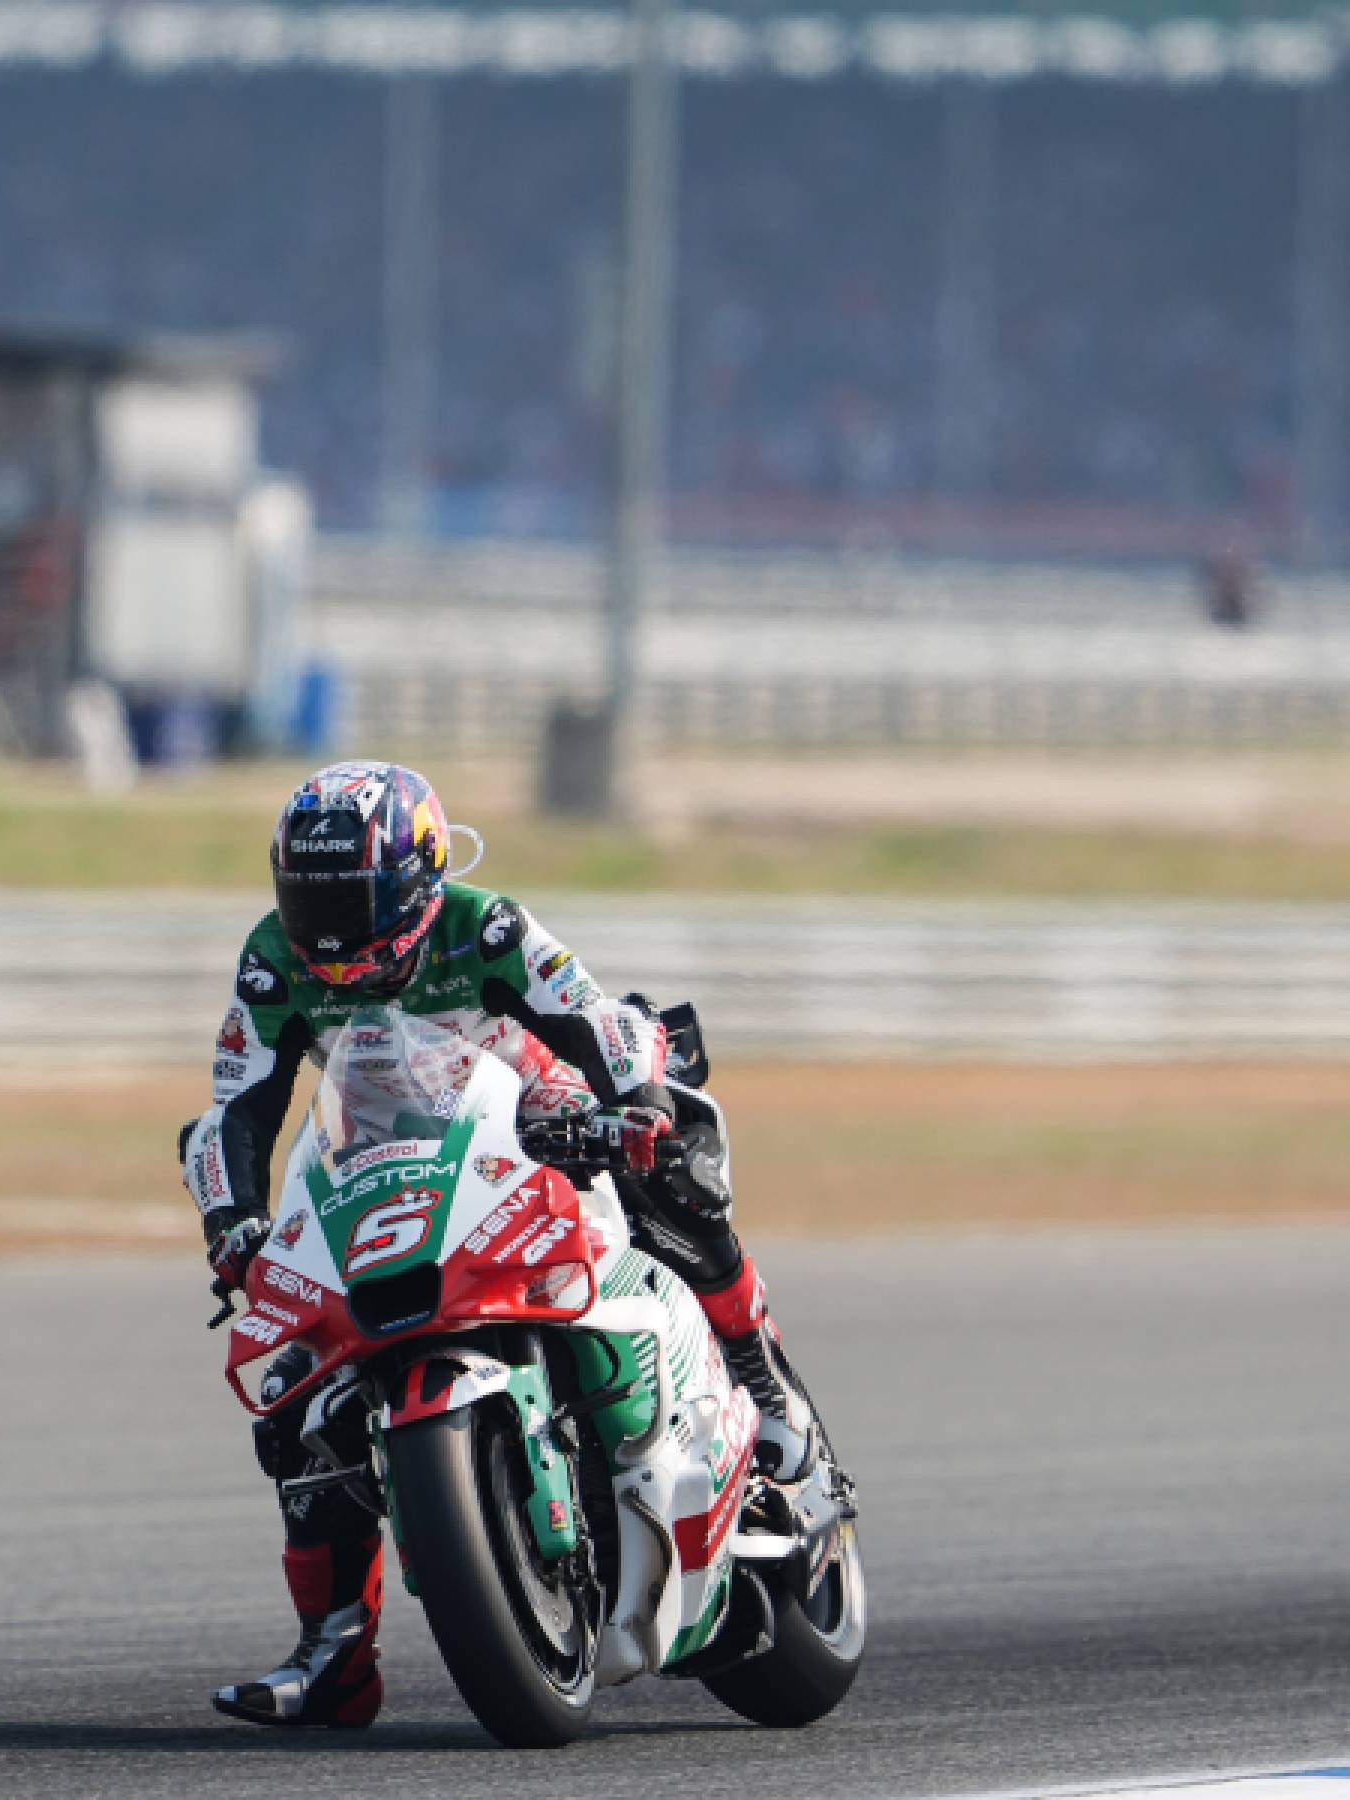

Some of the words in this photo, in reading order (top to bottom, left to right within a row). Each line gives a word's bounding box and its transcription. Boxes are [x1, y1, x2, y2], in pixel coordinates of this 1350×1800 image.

[290, 839, 355, 853] SHARK
[350, 1142, 418, 1174] Castrol
[320, 1160, 457, 1216] CUSTOM
[463, 1186, 541, 1255] SENA
[263, 1265, 322, 1309] SENA
